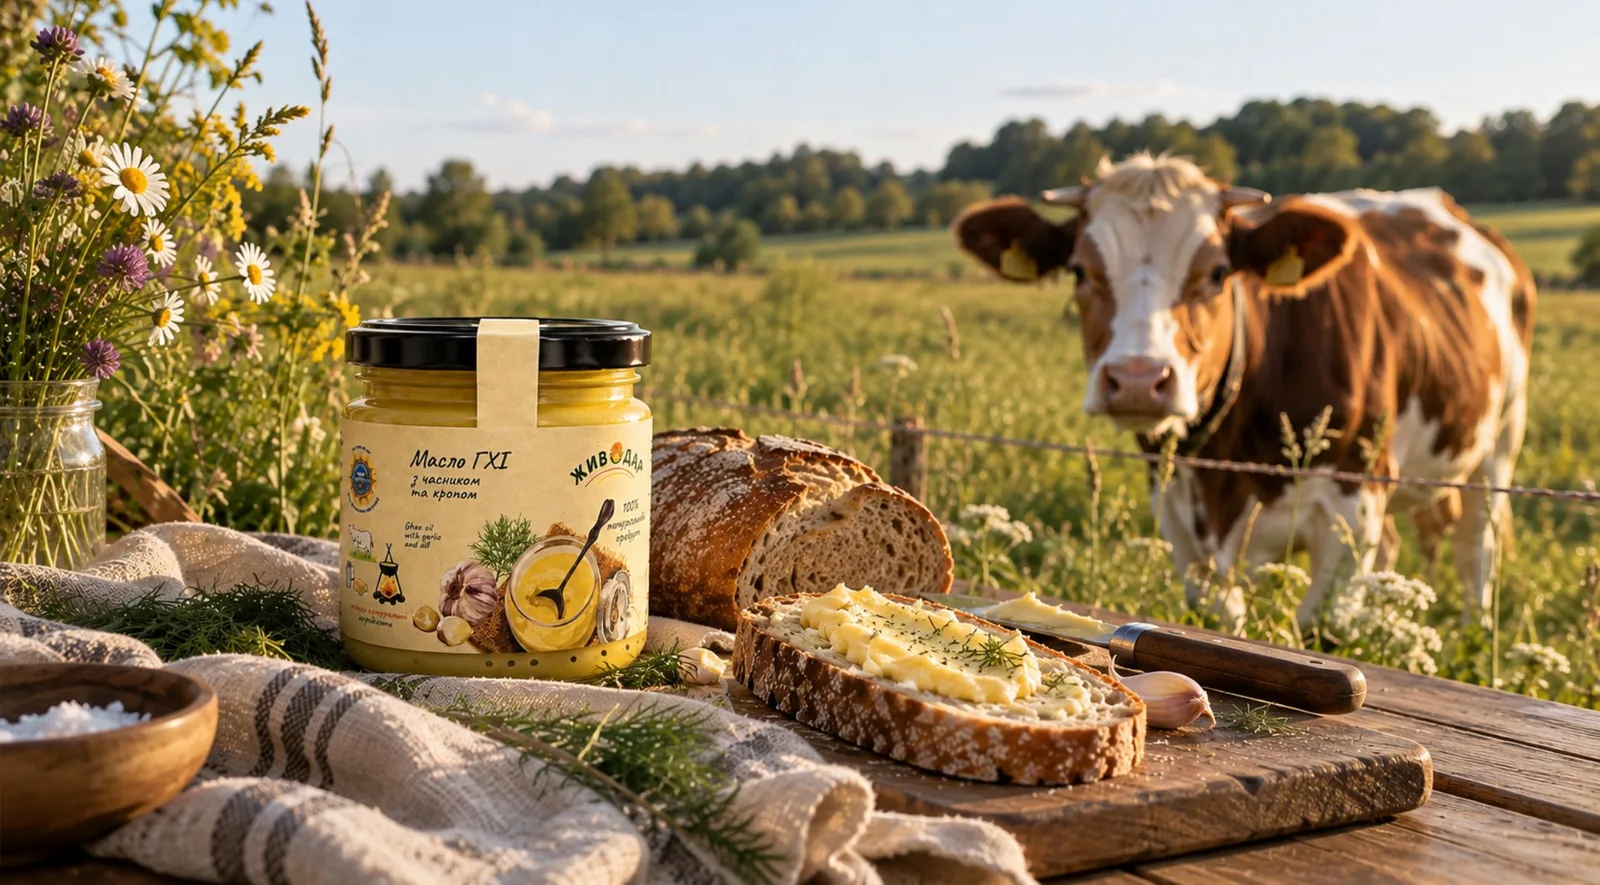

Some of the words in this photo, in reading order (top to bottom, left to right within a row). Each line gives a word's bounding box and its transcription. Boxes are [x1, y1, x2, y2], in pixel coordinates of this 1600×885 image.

[409, 449, 466, 469] Масло
[472, 451, 512, 470] ГХІ
[410, 475, 418, 488] з
[422, 475, 481, 486] часником
[411, 489, 428, 498] та
[432, 489, 477, 502] кропом
[404, 521, 422, 531] Ghee
